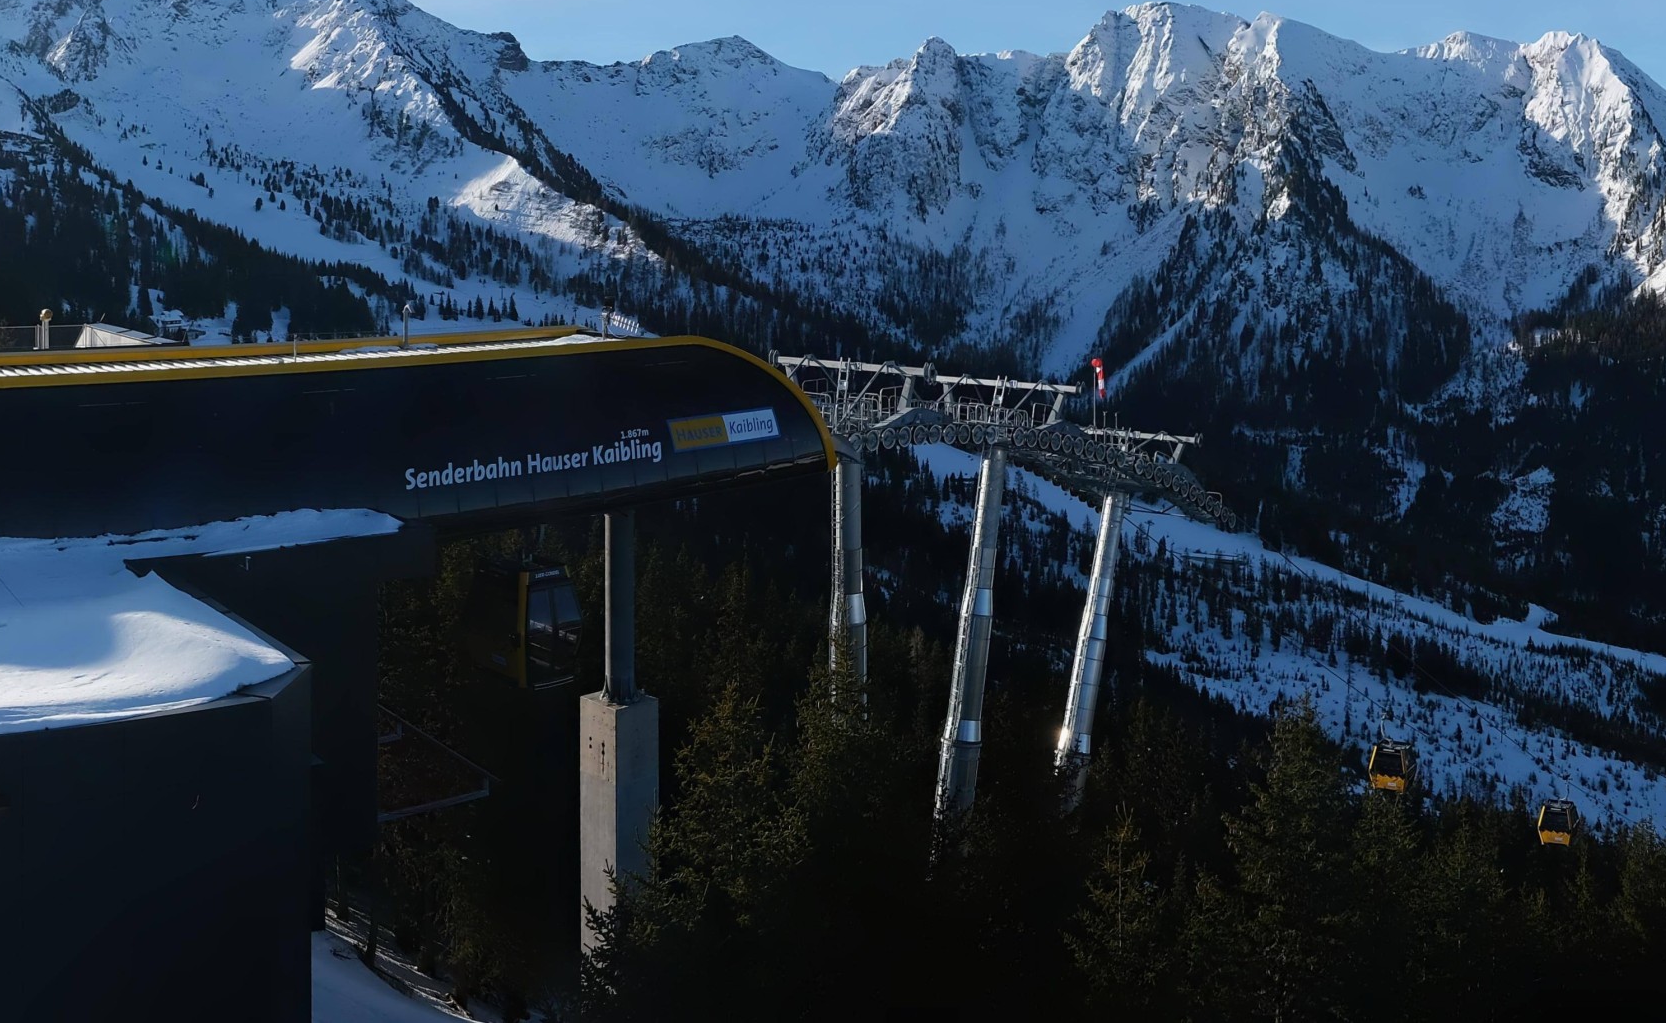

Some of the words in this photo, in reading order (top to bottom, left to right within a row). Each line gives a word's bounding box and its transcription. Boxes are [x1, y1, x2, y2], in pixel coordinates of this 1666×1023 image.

[620, 428, 649, 440] 1.867m
[675, 426, 723, 443] HAUSER
[728, 417, 774, 436] Kaibling
[405, 456, 522, 490] Senderbahn
[527, 451, 589, 475] Hauser
[593, 439, 662, 465] Kaibling
